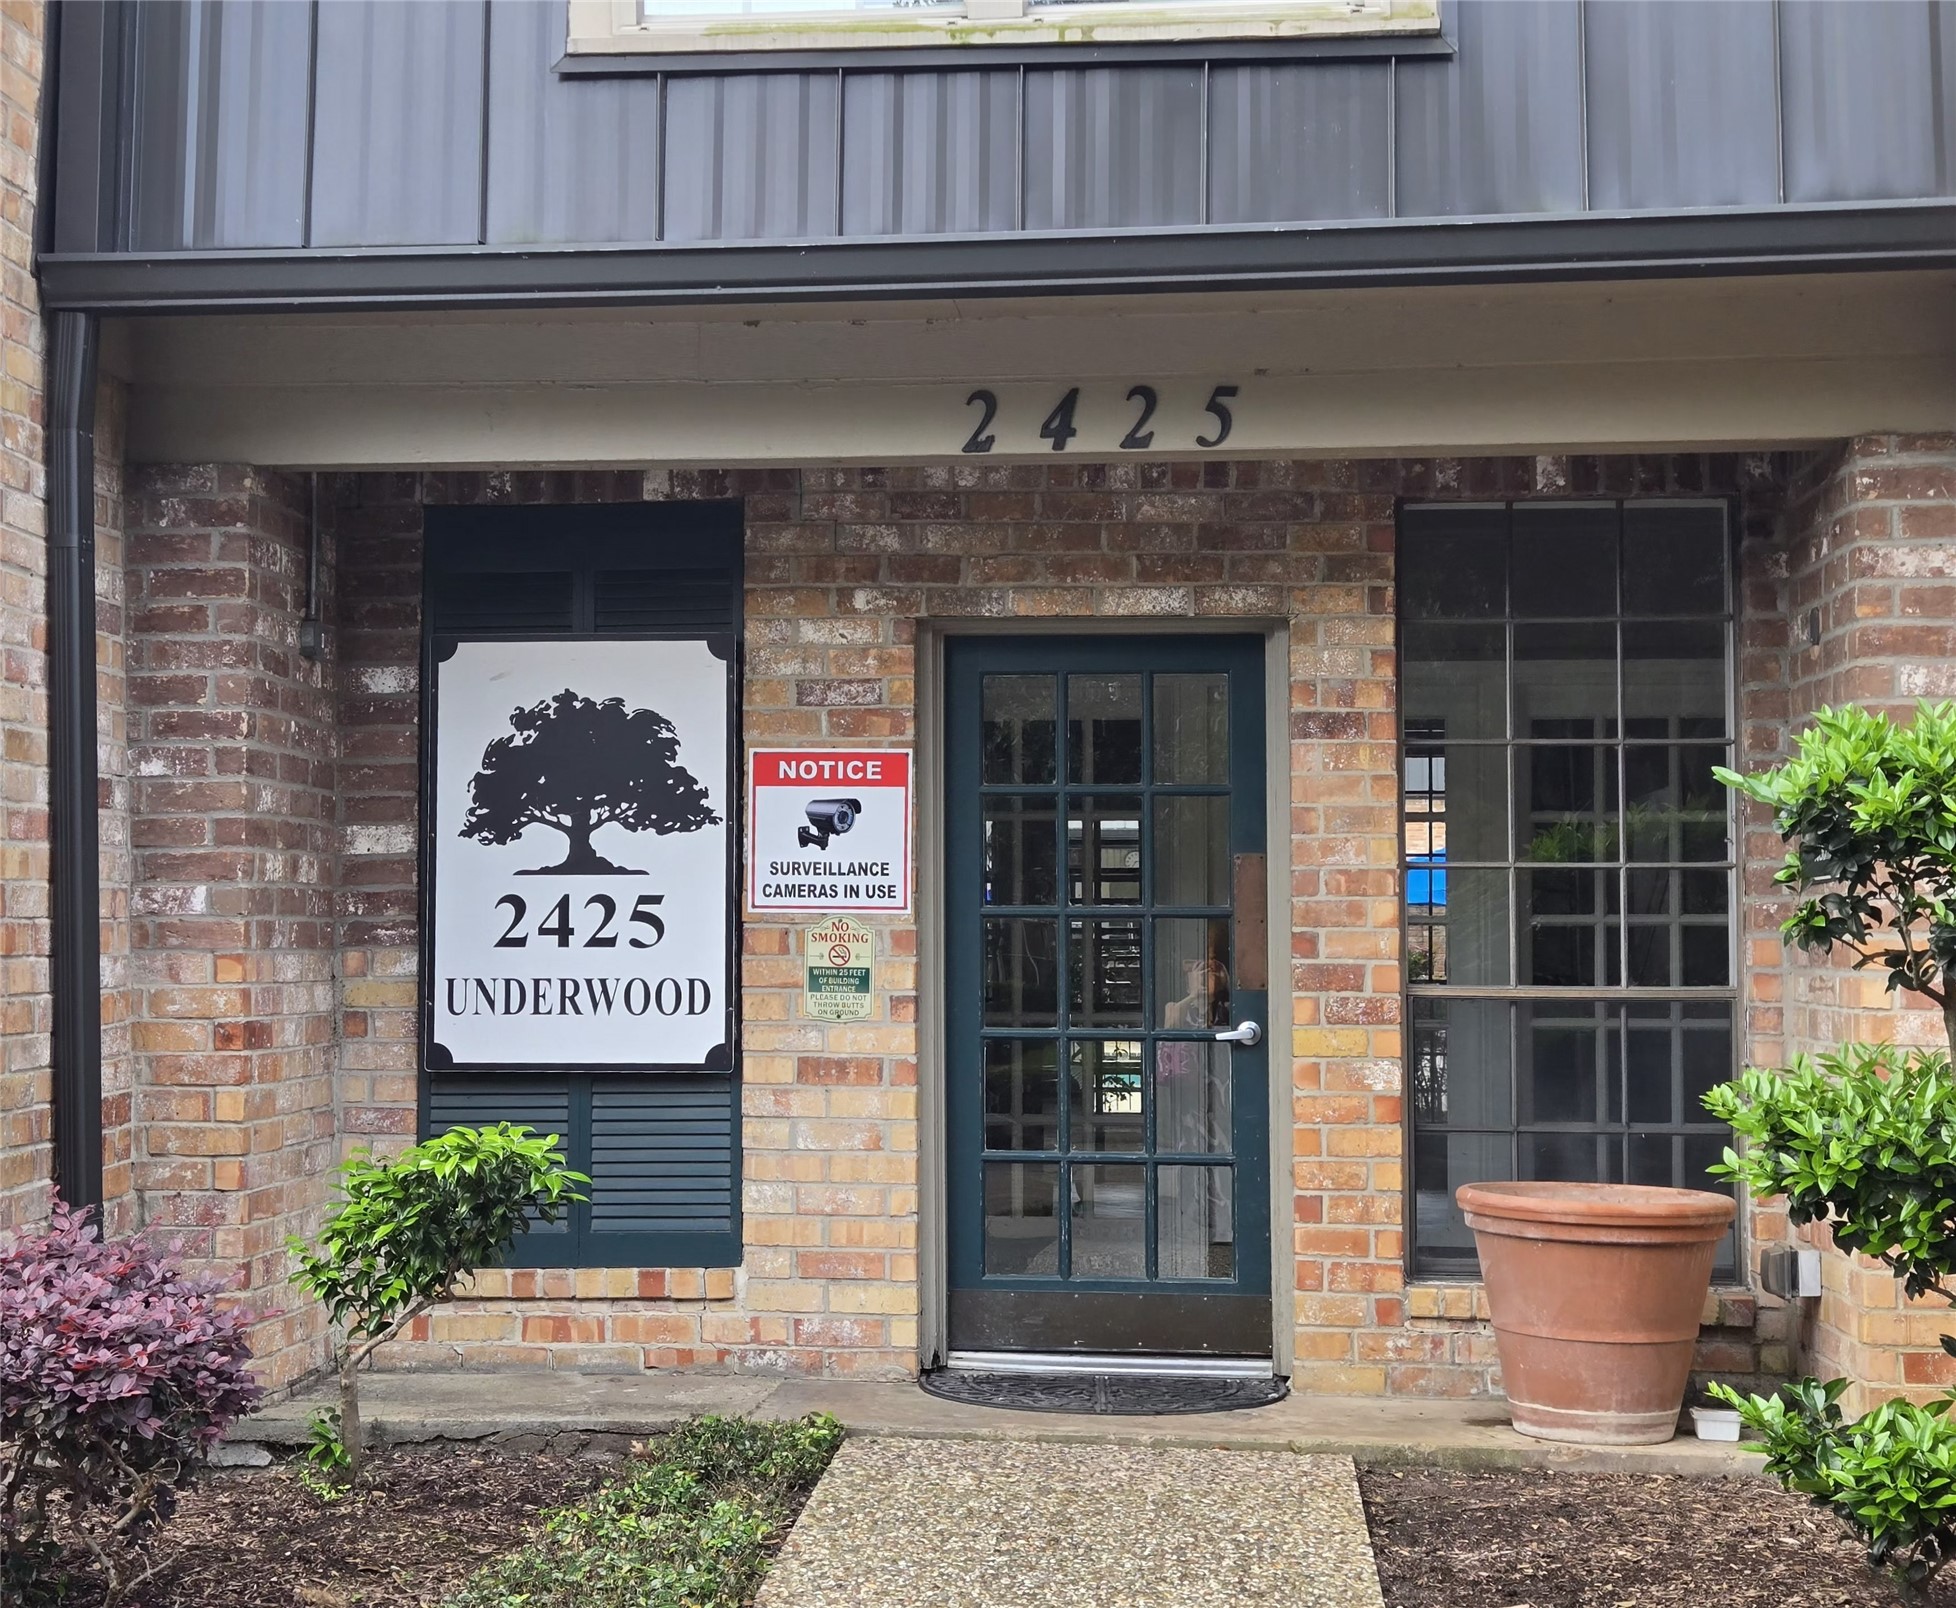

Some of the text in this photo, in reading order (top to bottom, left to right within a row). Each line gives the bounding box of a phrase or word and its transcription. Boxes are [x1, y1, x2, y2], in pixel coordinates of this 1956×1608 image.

[961, 385, 1239, 453] 2425
[778, 760, 882, 780] NOTICE
[770, 861, 890, 876] SURVEILLANCE
[762, 883, 897, 899] CAMERAS IN USE
[493, 893, 665, 949] 2425
[831, 921, 850, 932] NO
[811, 932, 869, 943] SMOKING
[812, 968, 838, 976] WITHIN
[839, 968, 848, 976] 25
[818, 976, 860, 985] OF BUILDING
[445, 976, 712, 1017] UNDERWOOD
[810, 993, 838, 1001] PLEASE
